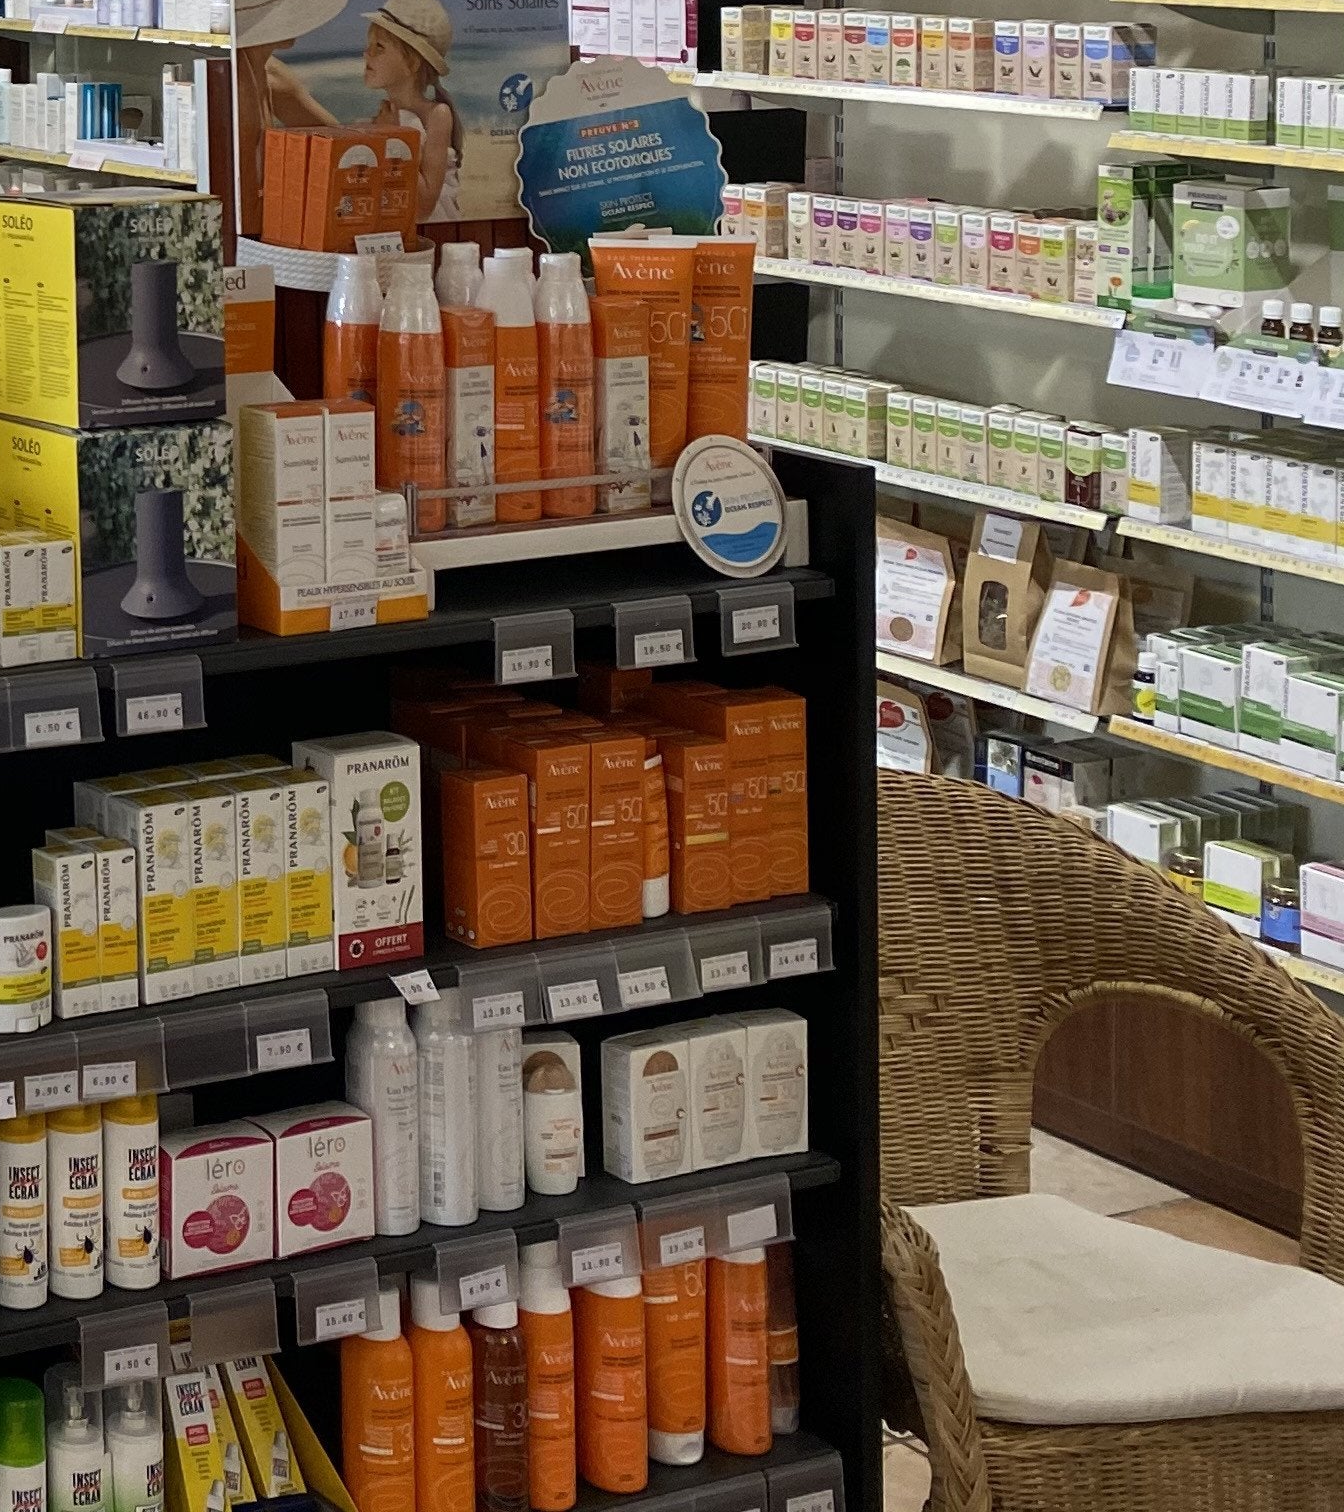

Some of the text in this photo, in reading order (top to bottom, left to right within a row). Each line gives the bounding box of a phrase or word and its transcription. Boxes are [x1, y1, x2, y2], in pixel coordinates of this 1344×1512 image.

[565, 132, 663, 161] FILTRES SOLAIRES
[558, 165, 589, 181] NON
[2, 214, 34, 232] SOLÉO
[611, 261, 675, 281] Avène
[12, 436, 42, 456] SOLÉO
[345, 753, 412, 777] PRANARÔM
[145, 812, 157, 893] PRANARÔM
[193, 805, 205, 885] PRANARÔM
[374, 933, 409, 949] OFFERT
[68, 1153, 99, 1173] INSECT
[128, 1144, 158, 1164] INSECT
[8, 1164, 41, 1182] INSECT
[69, 1175, 99, 1190] ECRAN
[72, 1468, 102, 1489] INSECT
[72, 1488, 102, 1507] ECRAN
